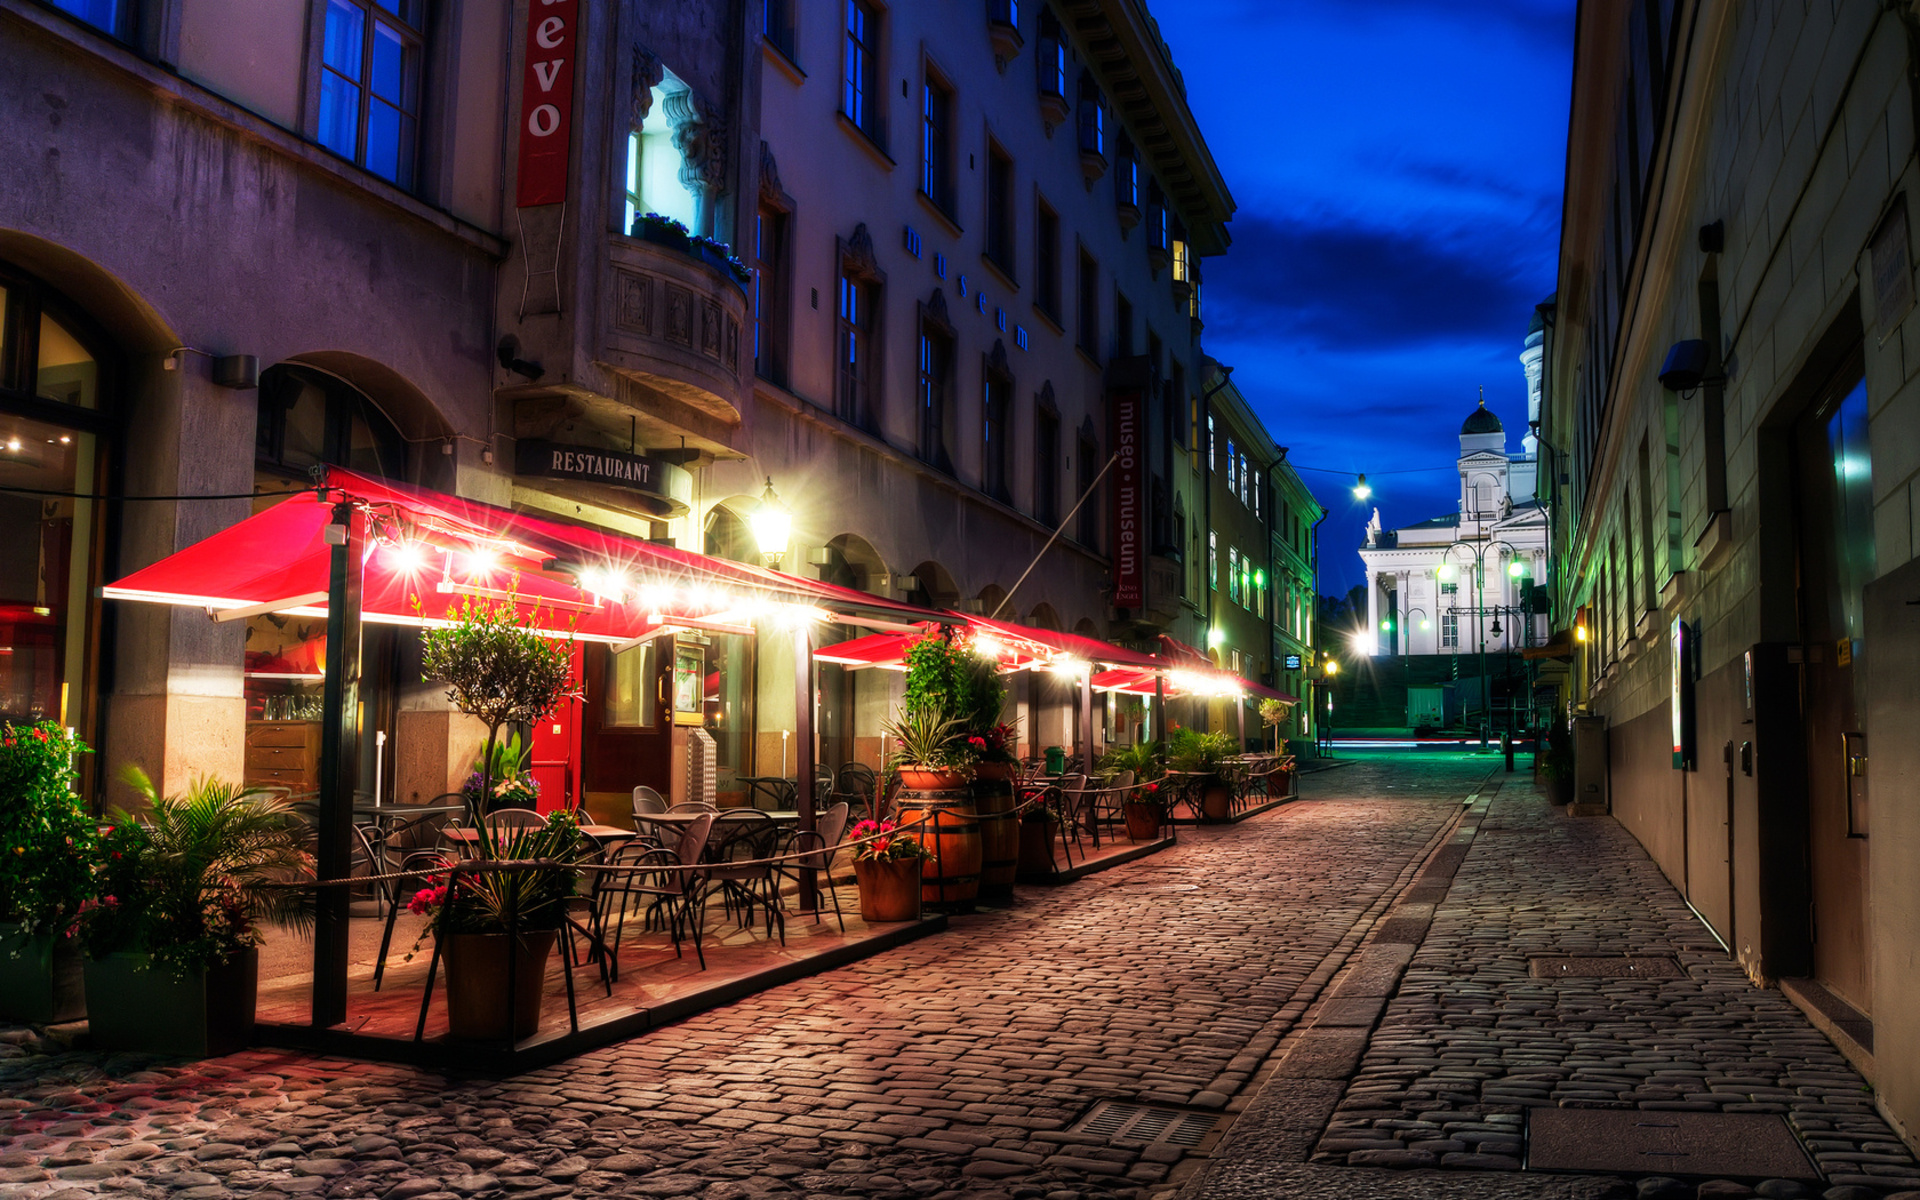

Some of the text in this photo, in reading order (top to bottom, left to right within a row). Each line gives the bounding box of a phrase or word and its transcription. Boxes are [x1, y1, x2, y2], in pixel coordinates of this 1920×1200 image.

[528, 0, 565, 137] evo
[906, 225, 1029, 351] museum
[551, 450, 650, 483] RESTAURANT
[1120, 402, 1135, 576] museo museum
